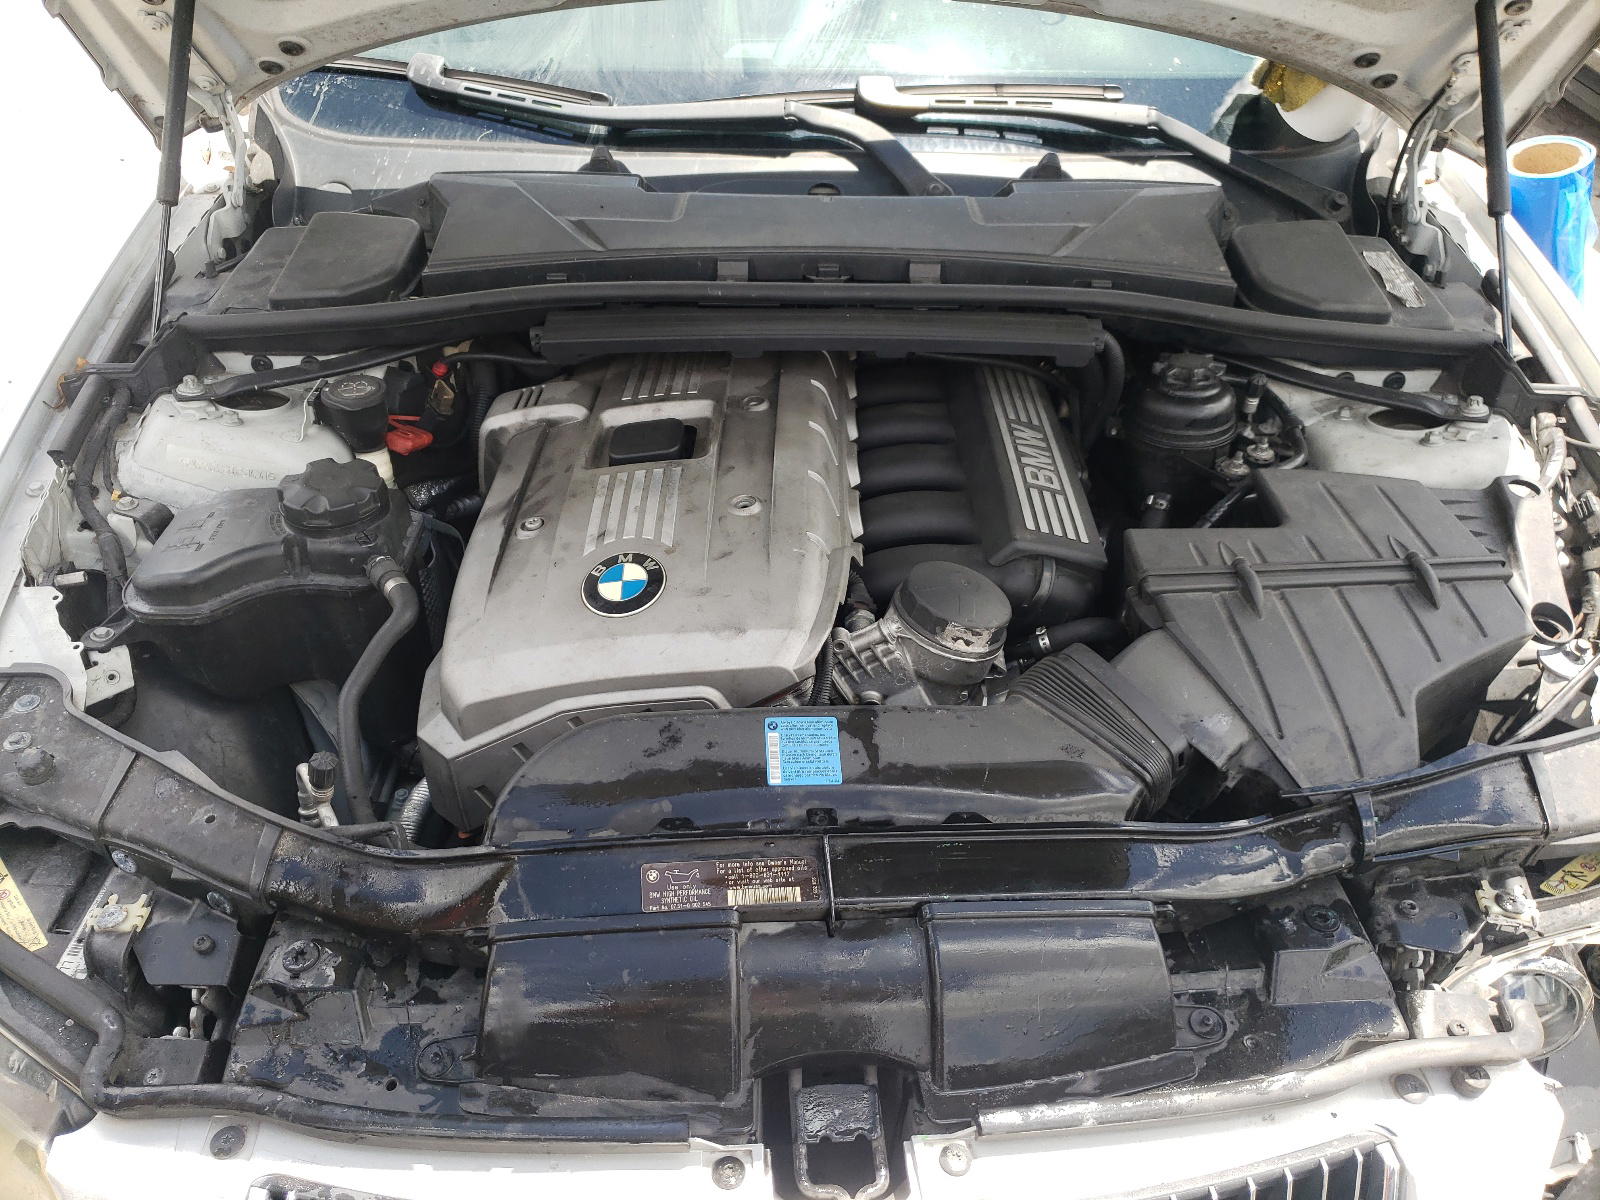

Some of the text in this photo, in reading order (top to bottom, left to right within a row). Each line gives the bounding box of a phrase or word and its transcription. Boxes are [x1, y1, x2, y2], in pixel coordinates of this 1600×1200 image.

[1010, 422, 1061, 490] BMW
[591, 553, 660, 577] BMW
[649, 888, 711, 899] BMW HIGH PERFORMANCE
